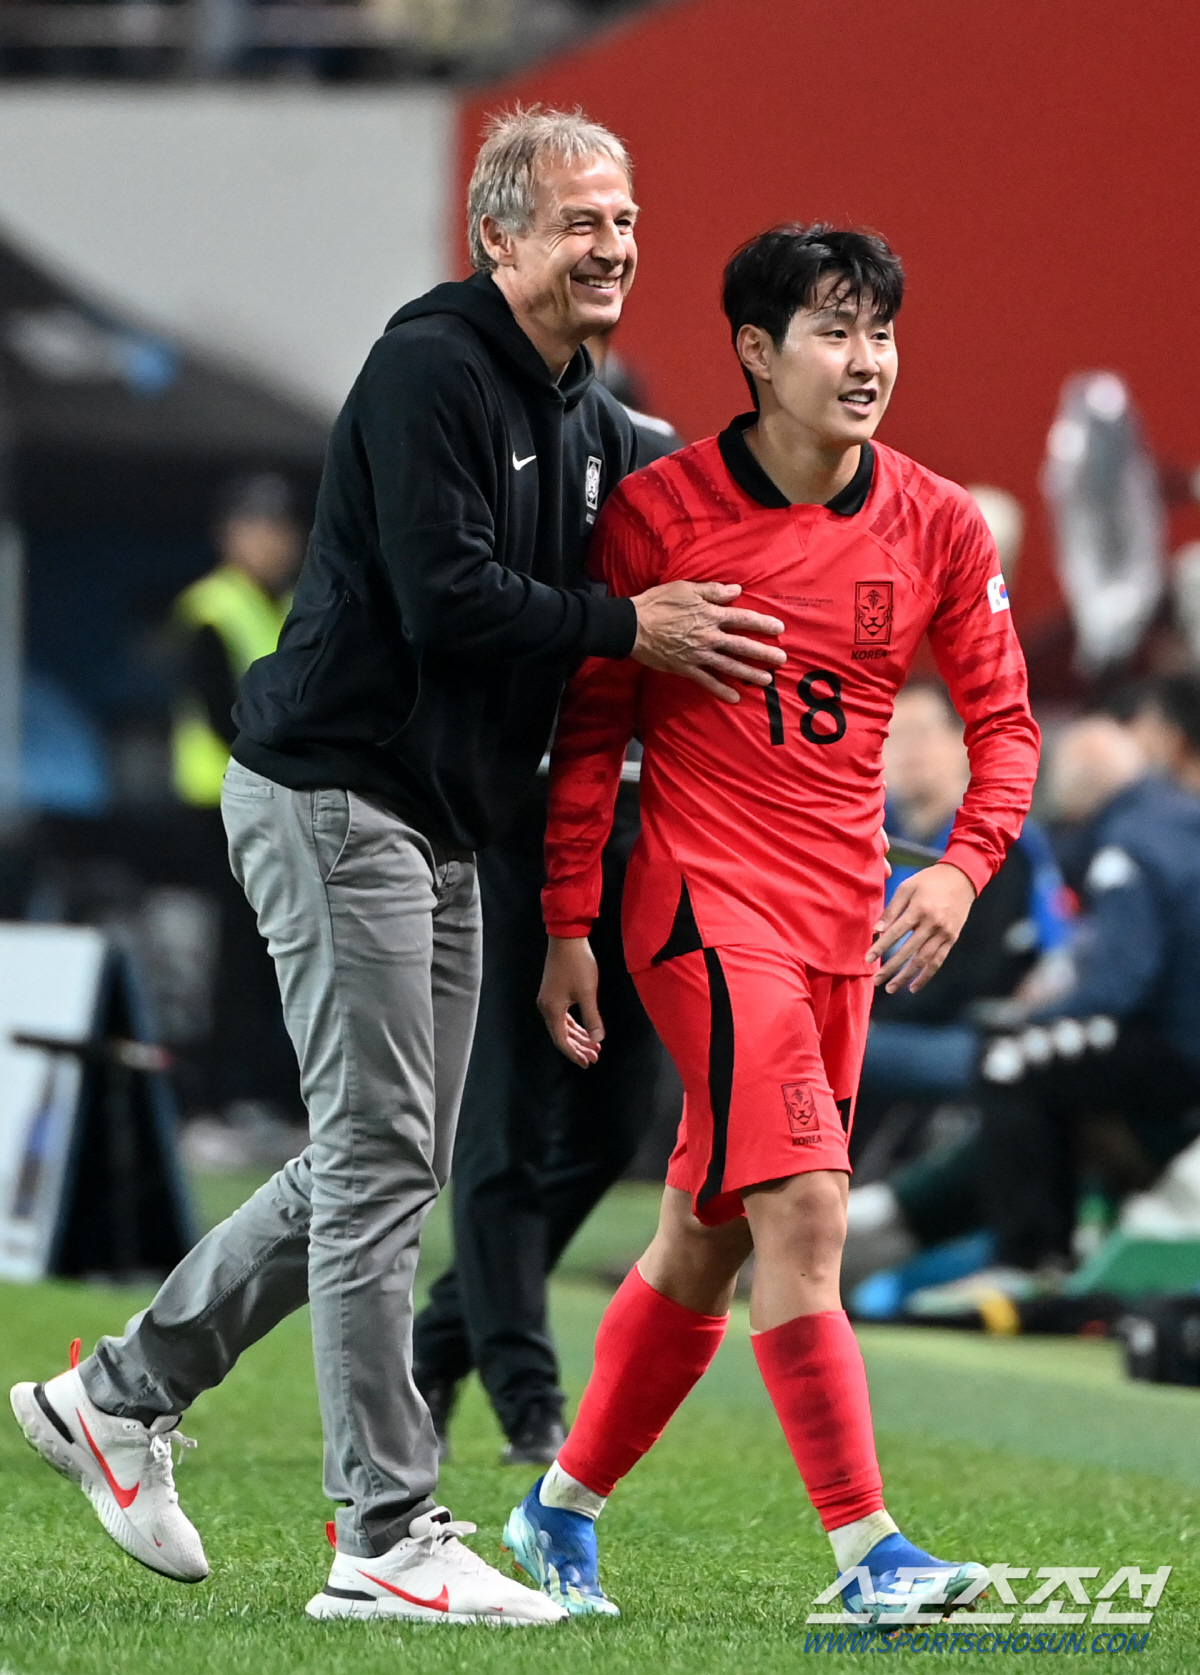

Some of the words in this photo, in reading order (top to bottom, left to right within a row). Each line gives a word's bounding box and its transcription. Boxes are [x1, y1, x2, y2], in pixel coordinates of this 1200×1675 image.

[851, 650, 888, 661] KOREA
[743, 669, 847, 746] 18
[792, 1135, 822, 1146] KOREA
